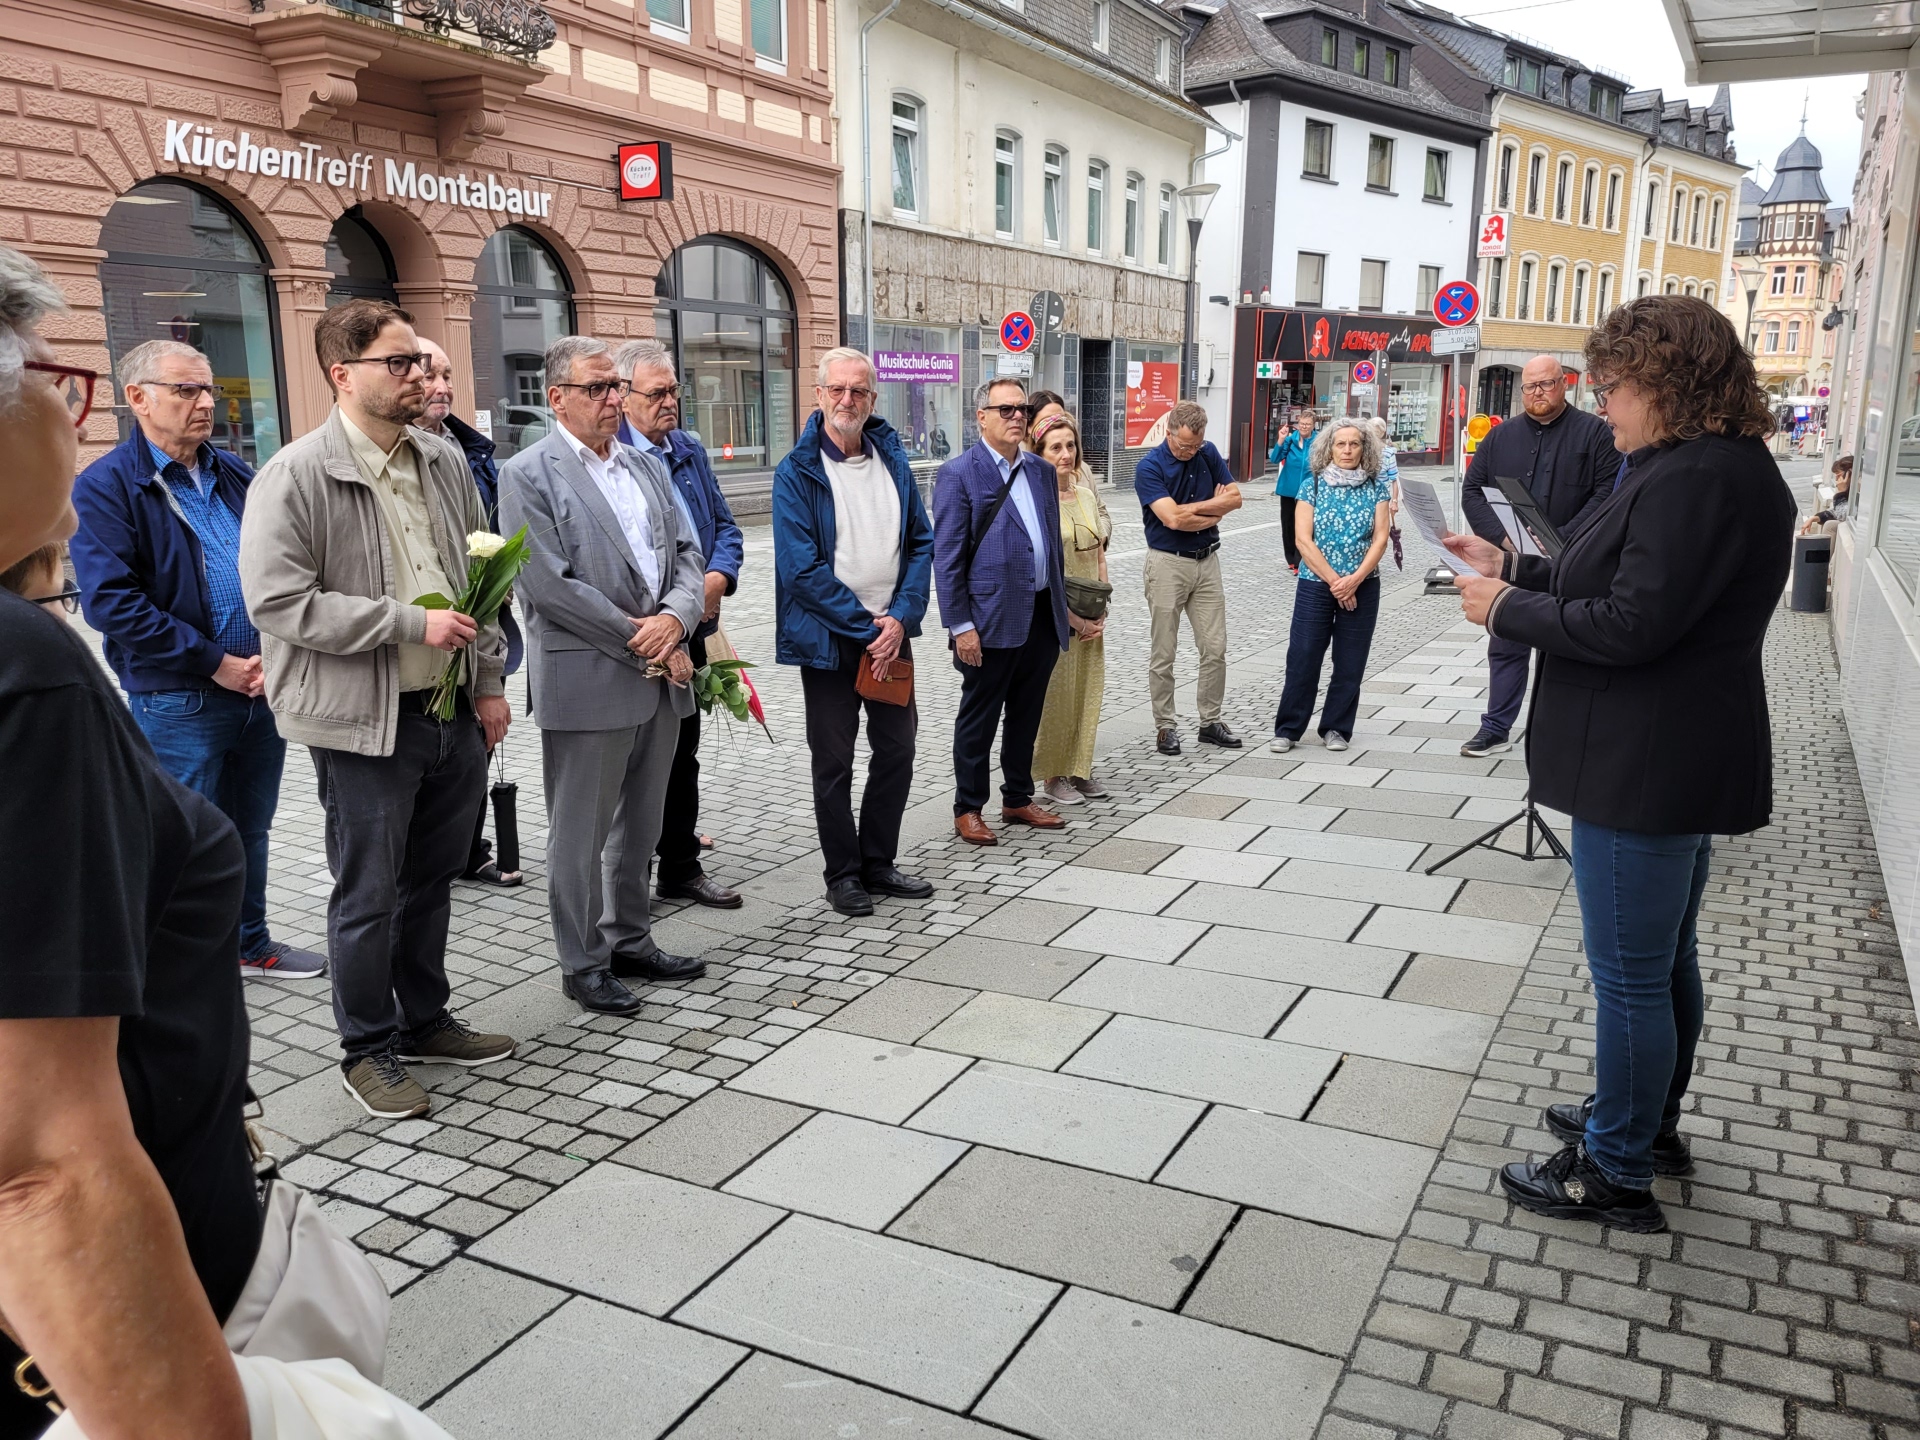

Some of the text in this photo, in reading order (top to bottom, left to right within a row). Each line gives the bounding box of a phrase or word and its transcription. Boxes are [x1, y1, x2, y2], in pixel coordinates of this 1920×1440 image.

[164, 119, 552, 218] KüchenTreff Montabaur
[629, 165, 652, 173] Küchen
[1341, 329, 1390, 351] SCHLOSS
[879, 353, 953, 370] Musikschule Gunia
